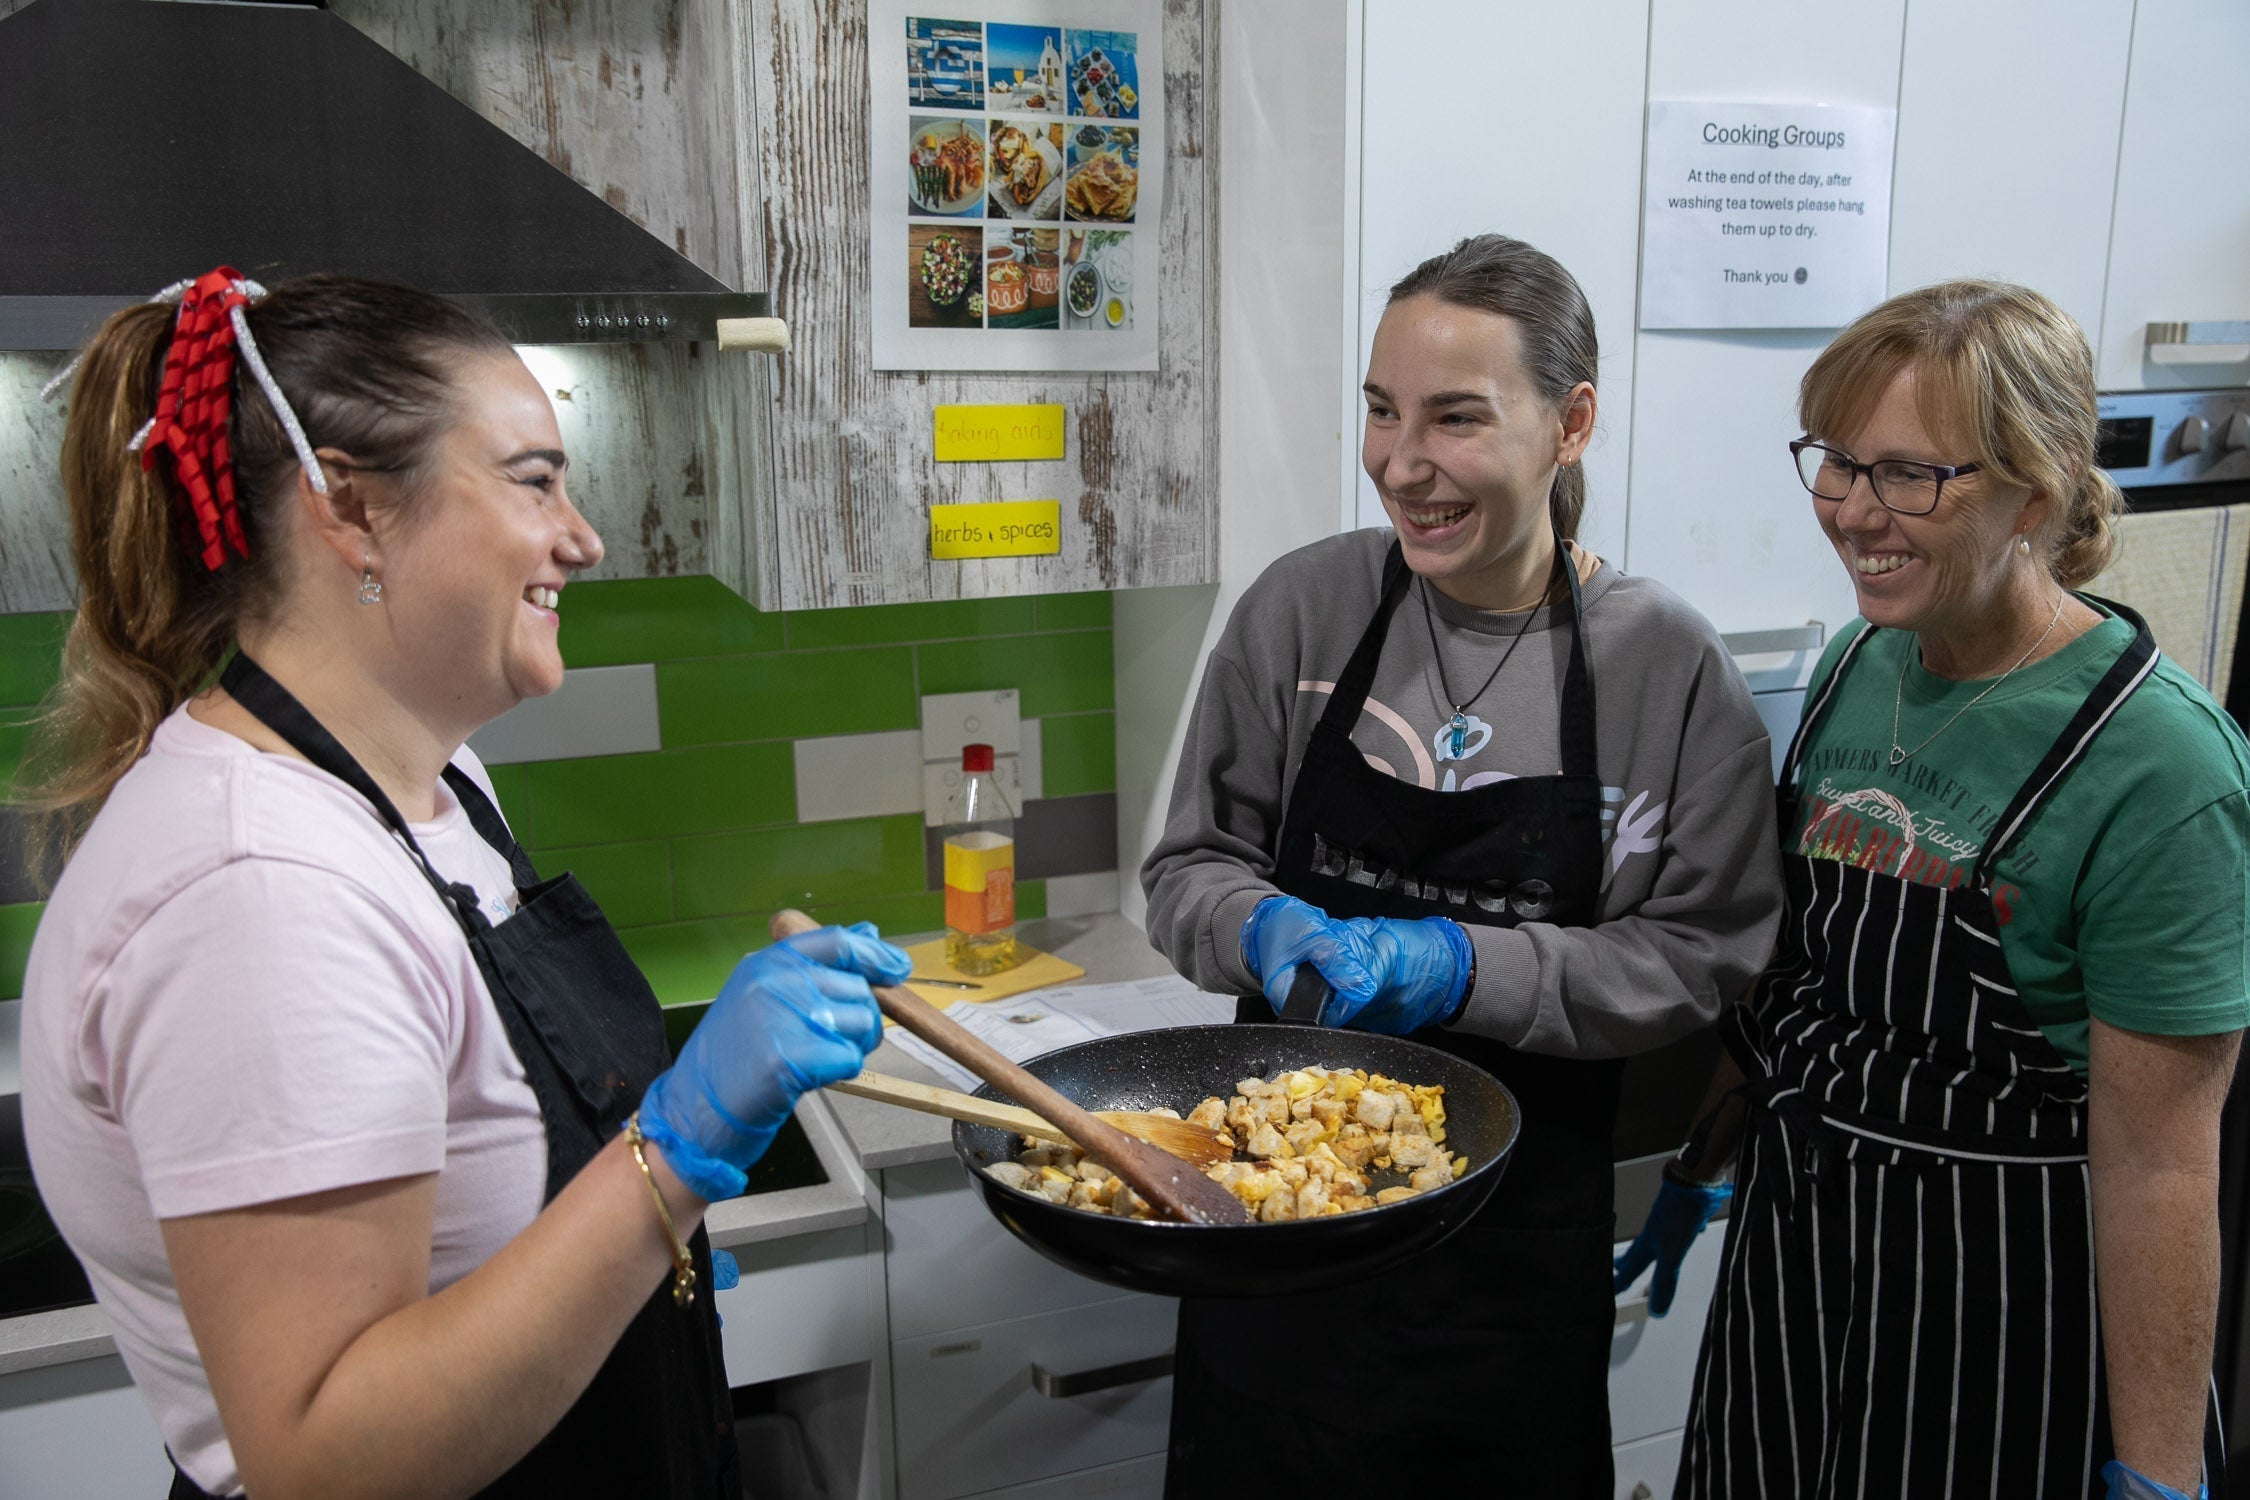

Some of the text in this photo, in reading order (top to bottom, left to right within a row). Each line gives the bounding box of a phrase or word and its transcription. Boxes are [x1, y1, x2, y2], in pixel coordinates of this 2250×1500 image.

[1702, 122, 1845, 150] Cooking Groups
[1687, 168, 1852, 189] At the end of the day, after
[1668, 195, 1865, 216] washing tea towels please hang
[1721, 222, 1818, 240] them up to dry.
[1723, 269, 1789, 287] Thank you
[934, 521, 983, 543] herbs
[1000, 520, 1053, 545] spices
[1912, 817, 1980, 862] Juicy
